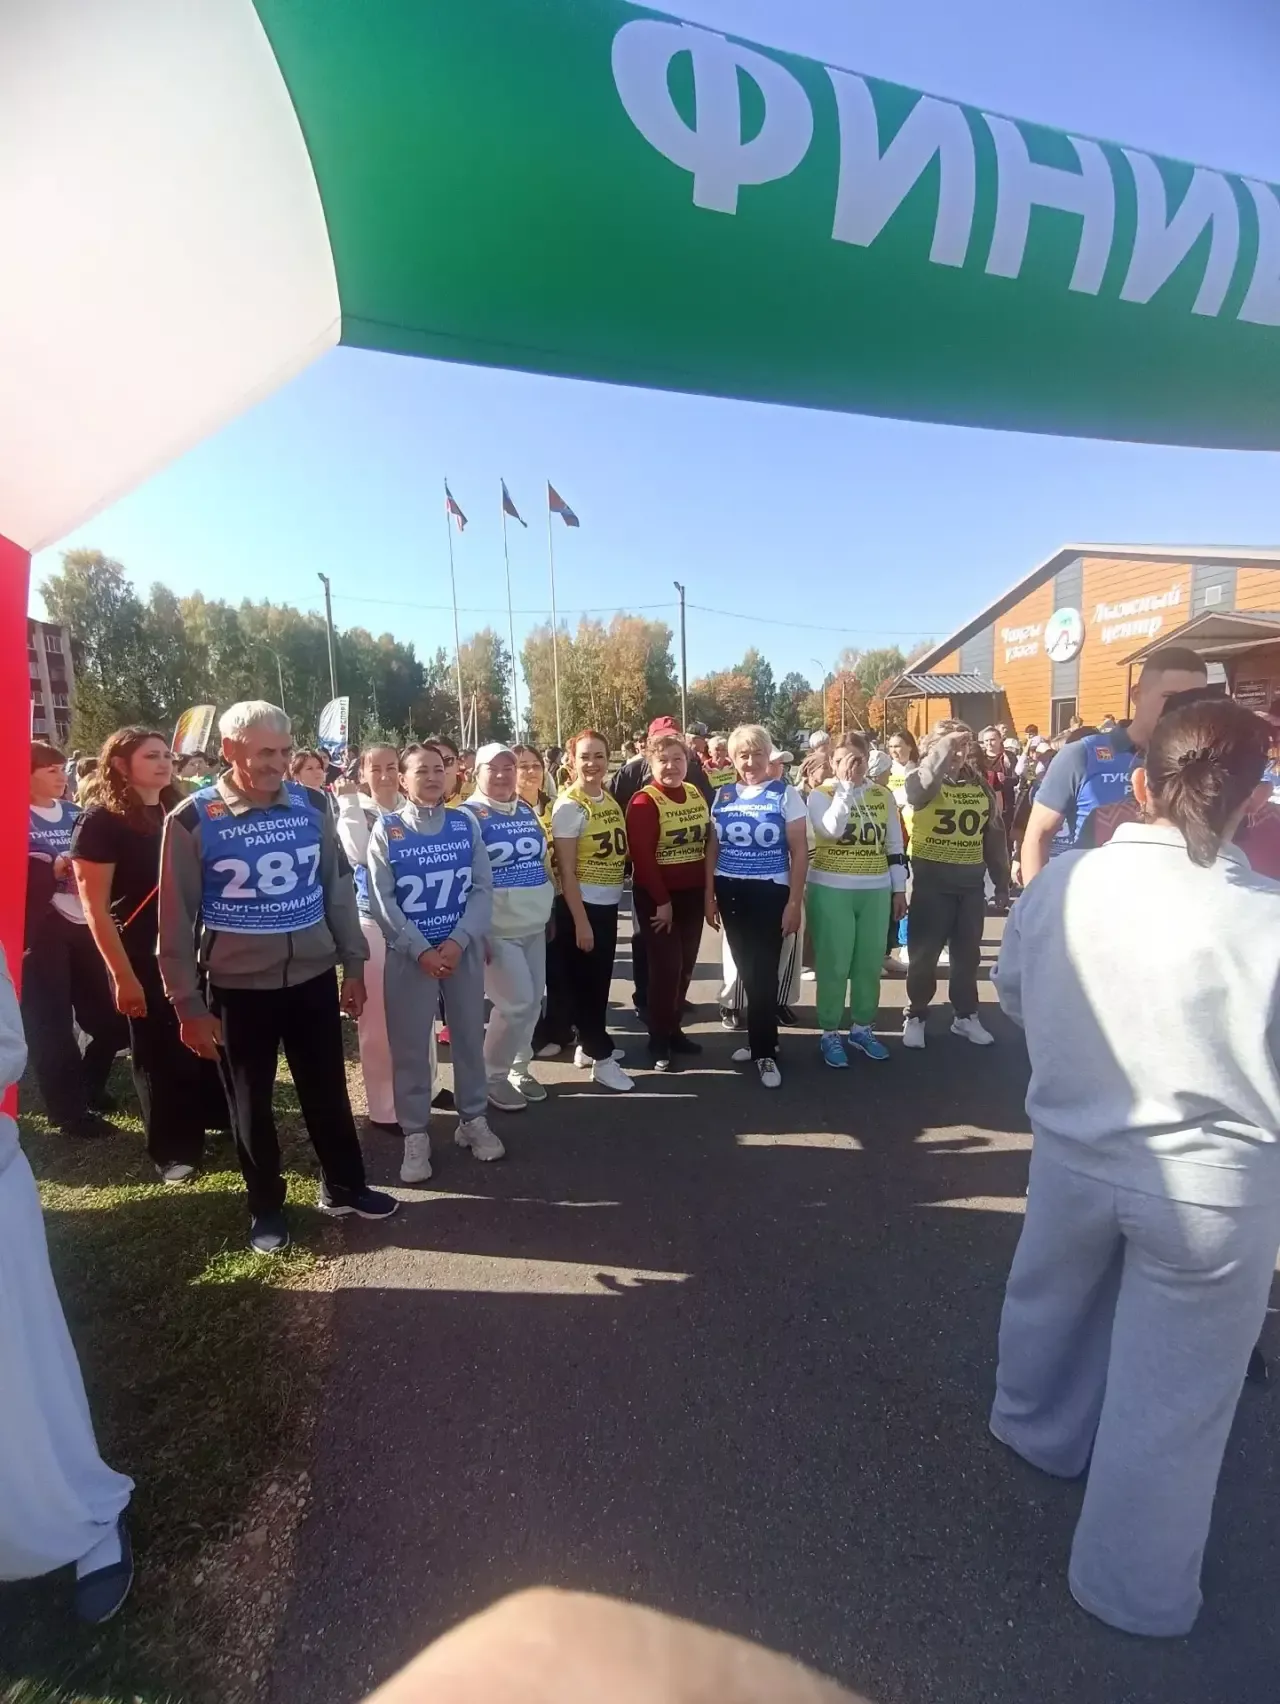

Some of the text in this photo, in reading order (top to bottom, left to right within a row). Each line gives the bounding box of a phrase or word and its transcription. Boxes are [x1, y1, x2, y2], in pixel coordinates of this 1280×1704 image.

[1101, 615, 1164, 645] центр
[29, 829, 72, 840] ТУКАЕВС
[219, 816, 309, 840] ТУКАЕВСКИЙ
[50, 837, 72, 846] РАЙО
[245, 830, 296, 847] РАЙОН
[398, 839, 471, 858] ТУКАЕВСКИЙ
[418, 852, 458, 866] РАЙОН
[212, 843, 321, 898] 287
